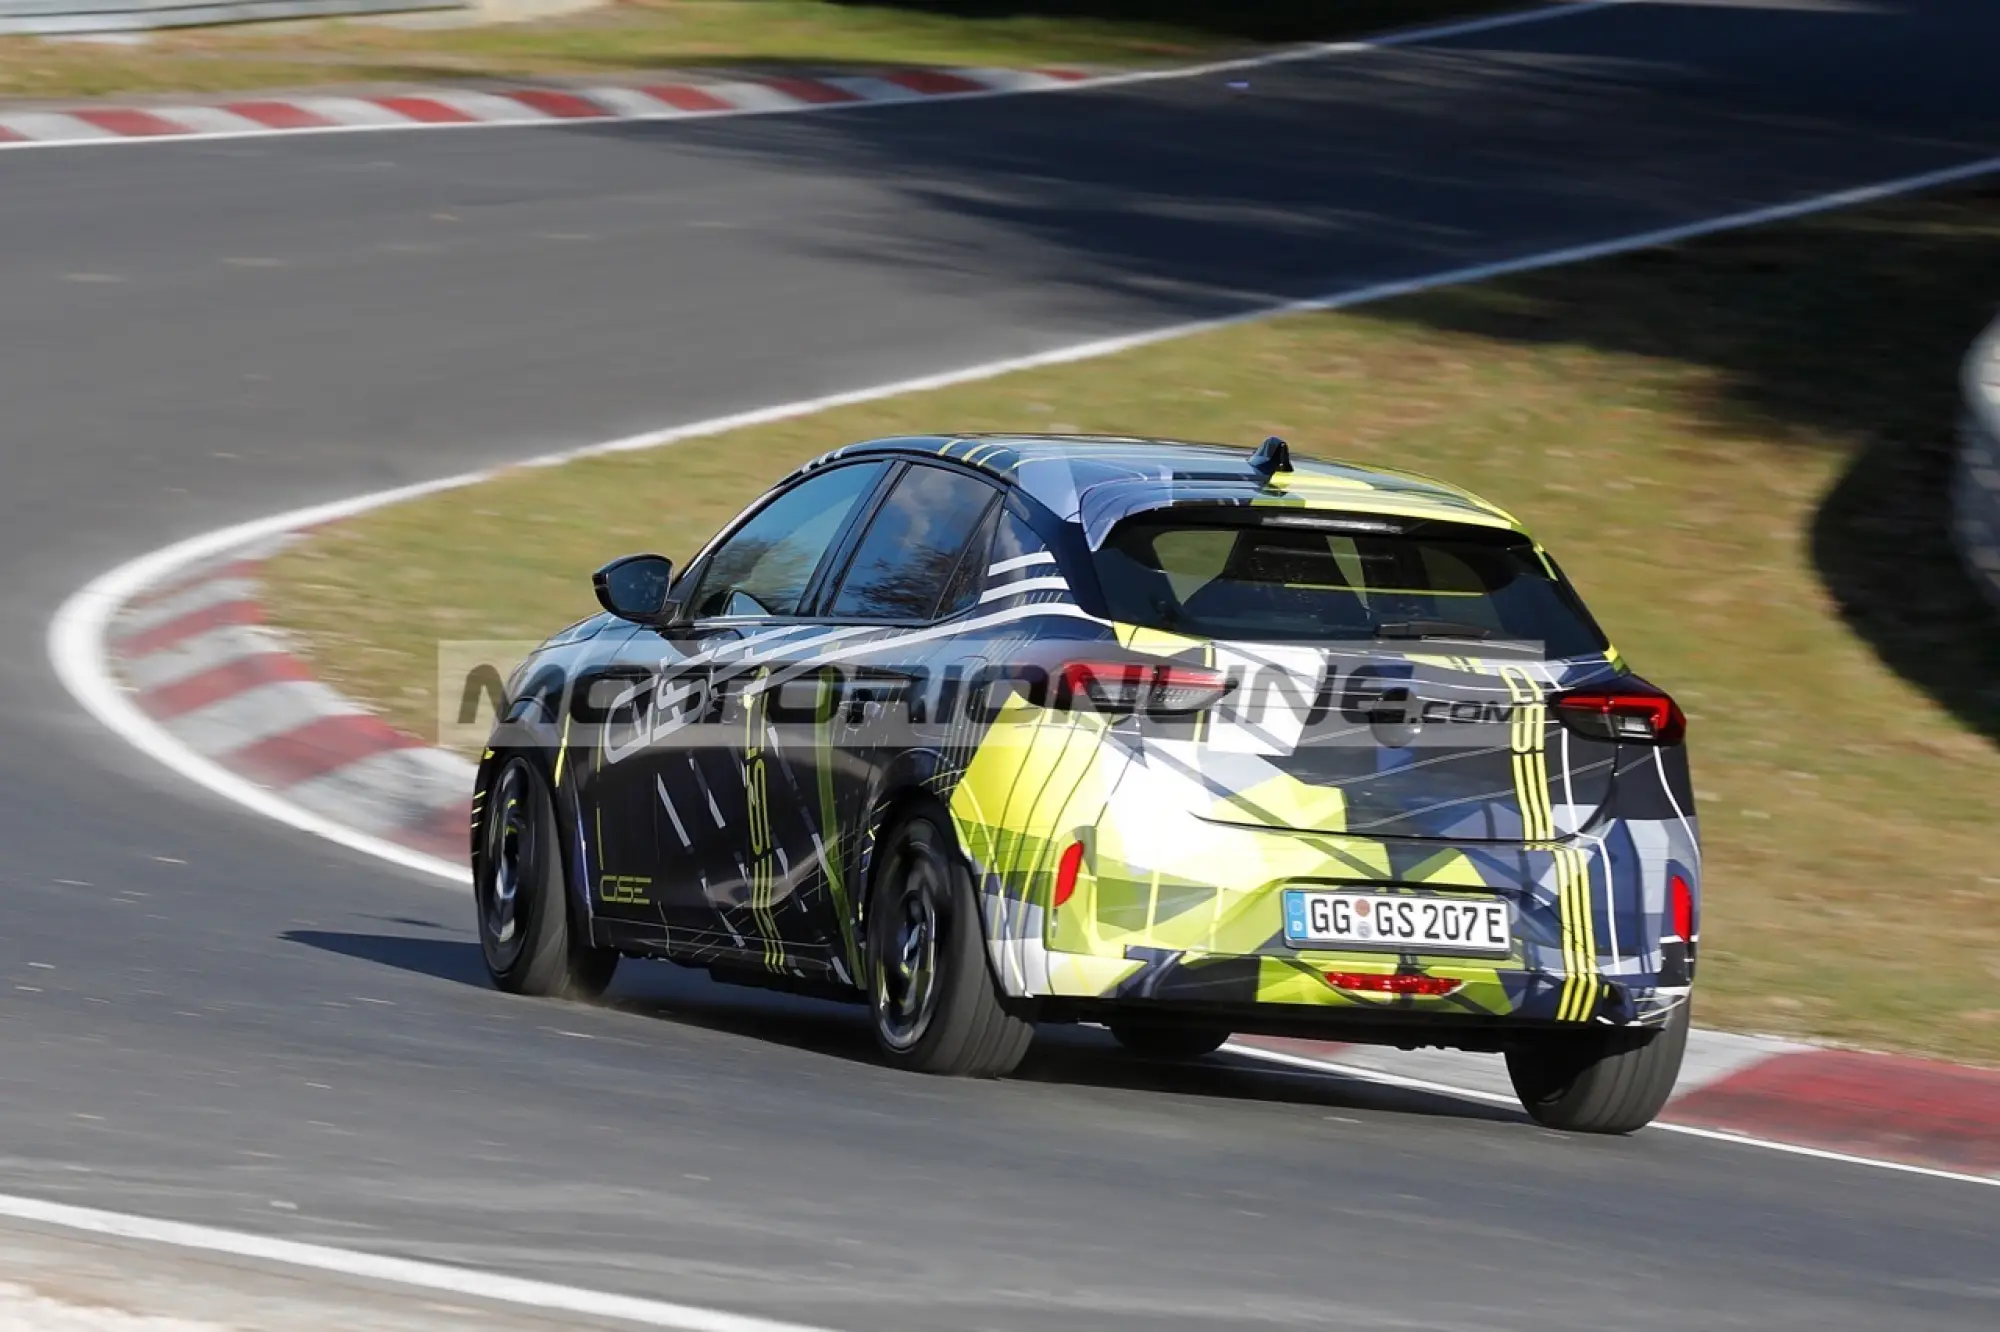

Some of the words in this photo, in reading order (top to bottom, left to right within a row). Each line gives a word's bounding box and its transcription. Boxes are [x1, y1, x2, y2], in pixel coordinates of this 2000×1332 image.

[600, 874, 652, 905] GSE
[1311, 898, 1351, 934] GG
[1375, 902, 1415, 938] GS
